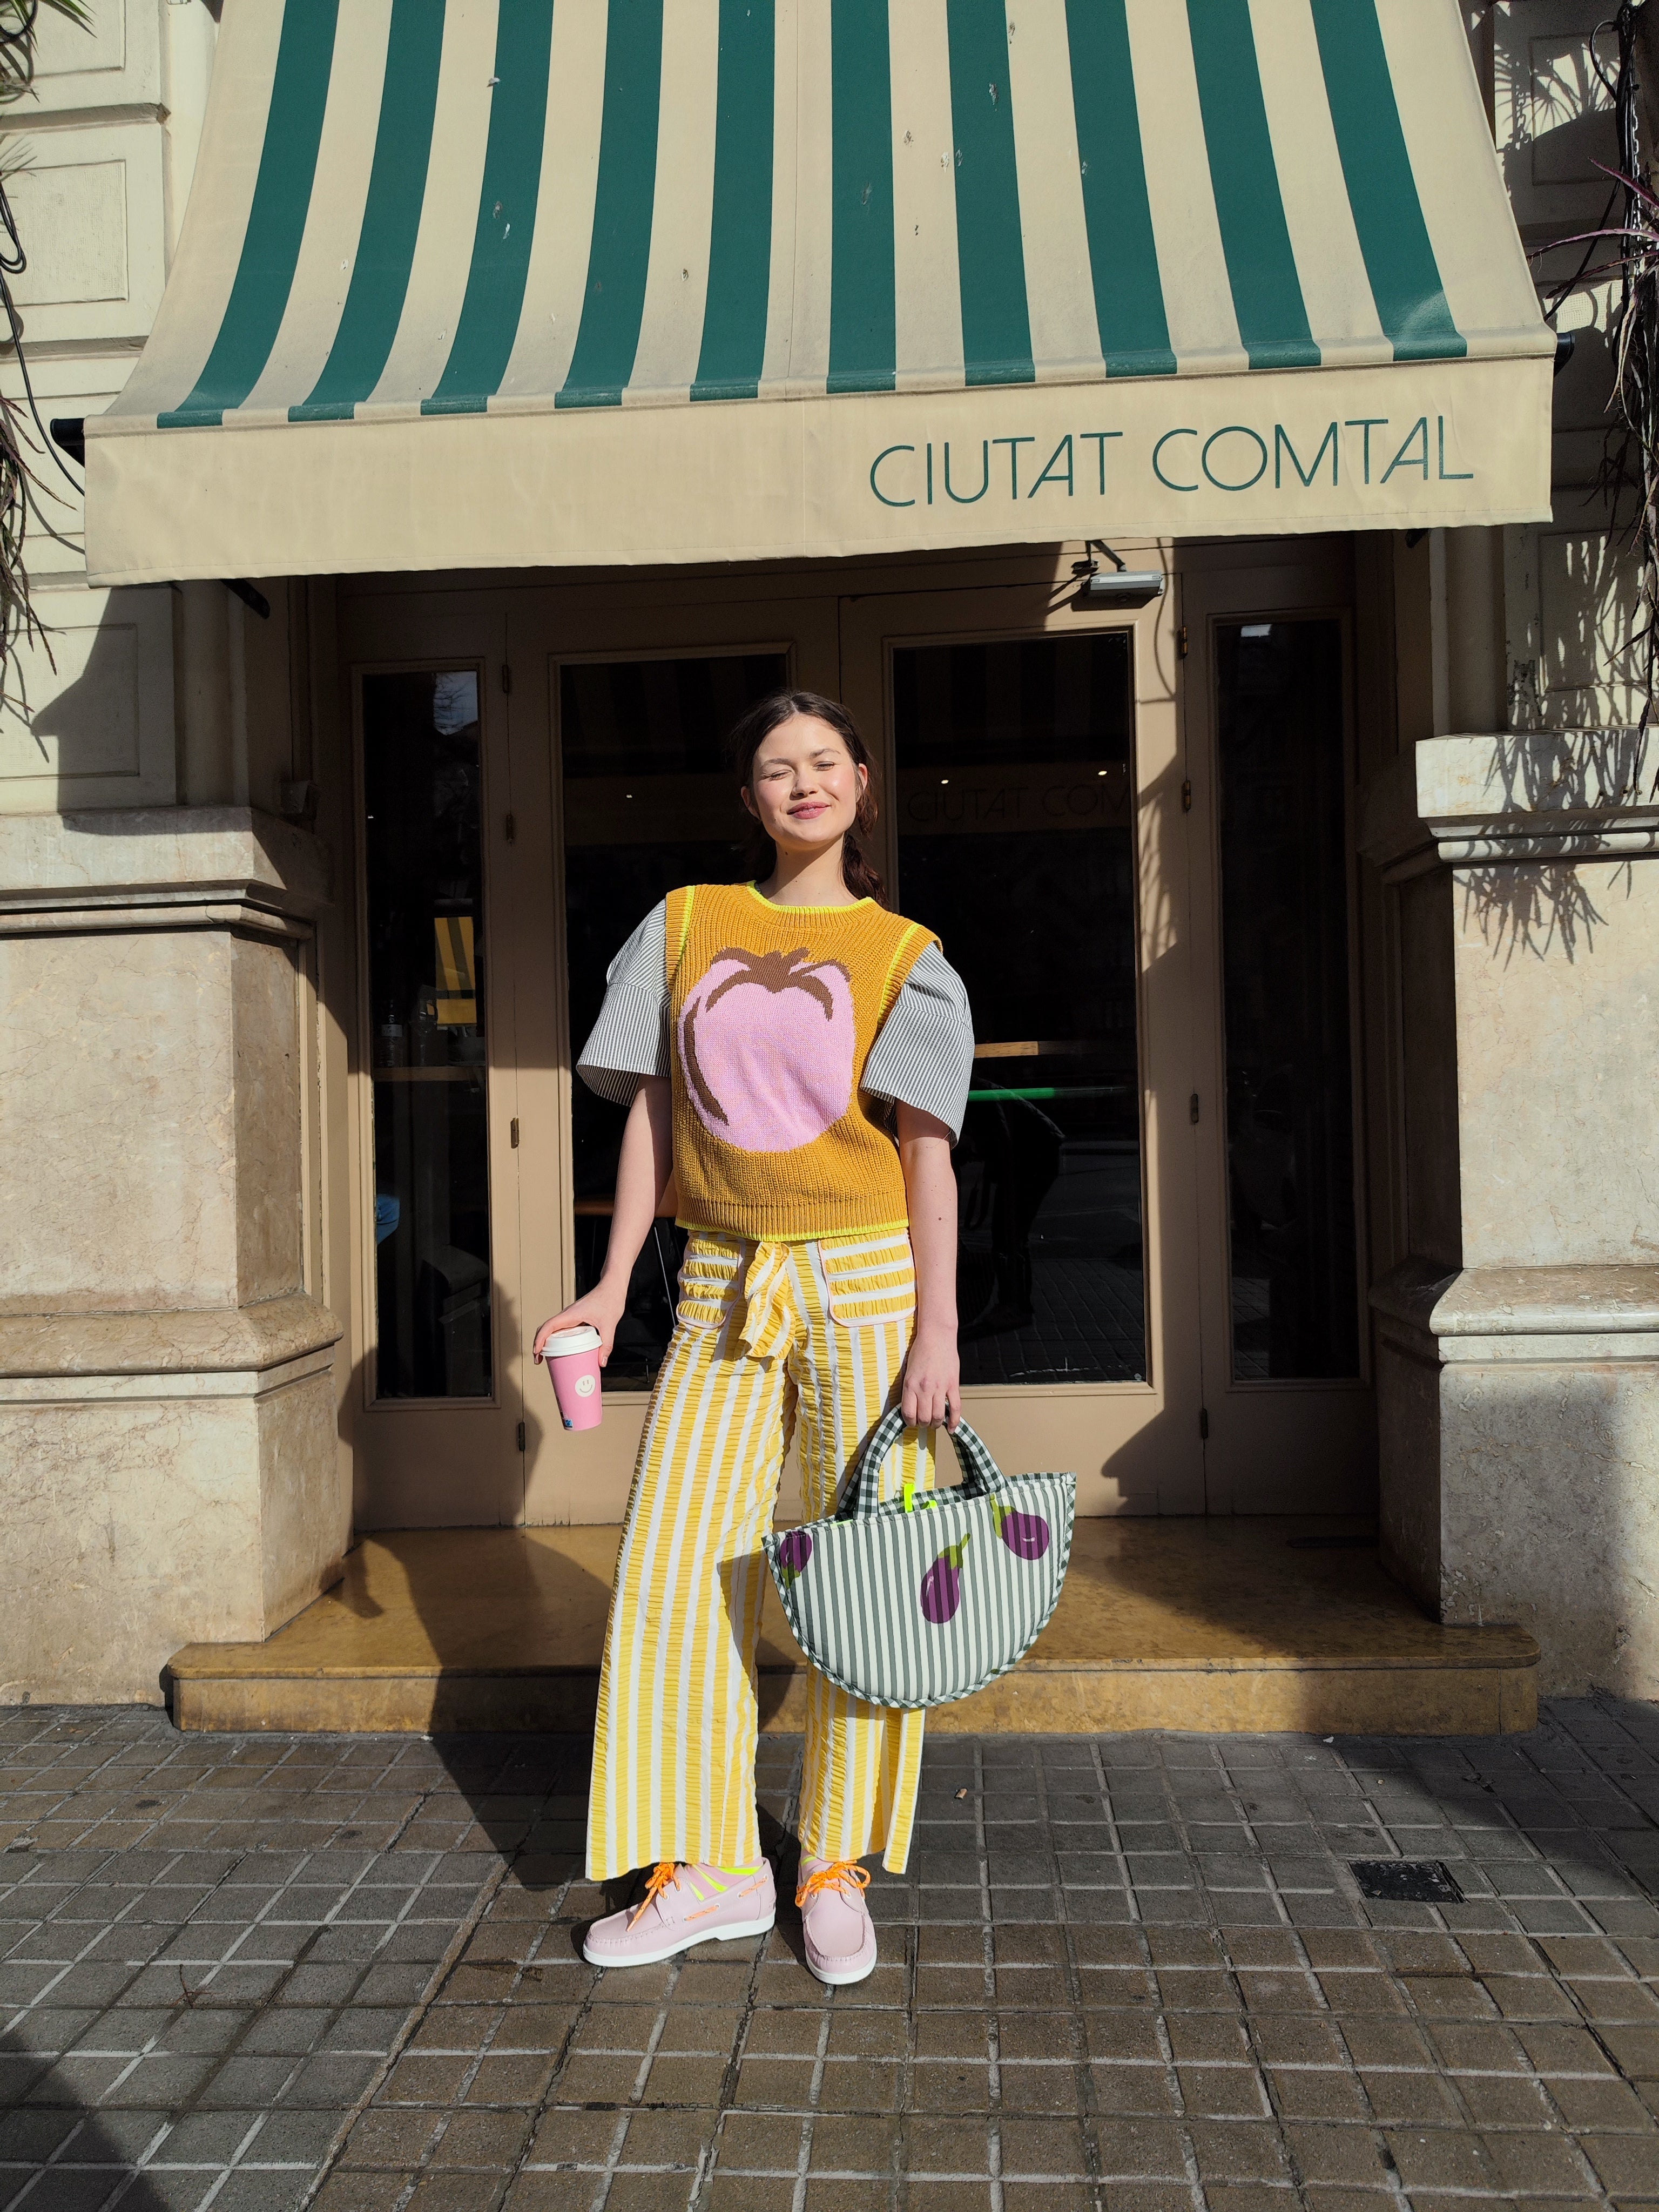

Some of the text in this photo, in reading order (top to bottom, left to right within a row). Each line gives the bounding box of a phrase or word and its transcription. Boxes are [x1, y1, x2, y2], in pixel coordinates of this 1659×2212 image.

[870, 415, 1474, 507] CIUTAT COMTAL
[907, 787, 1029, 822] CIUTAT
